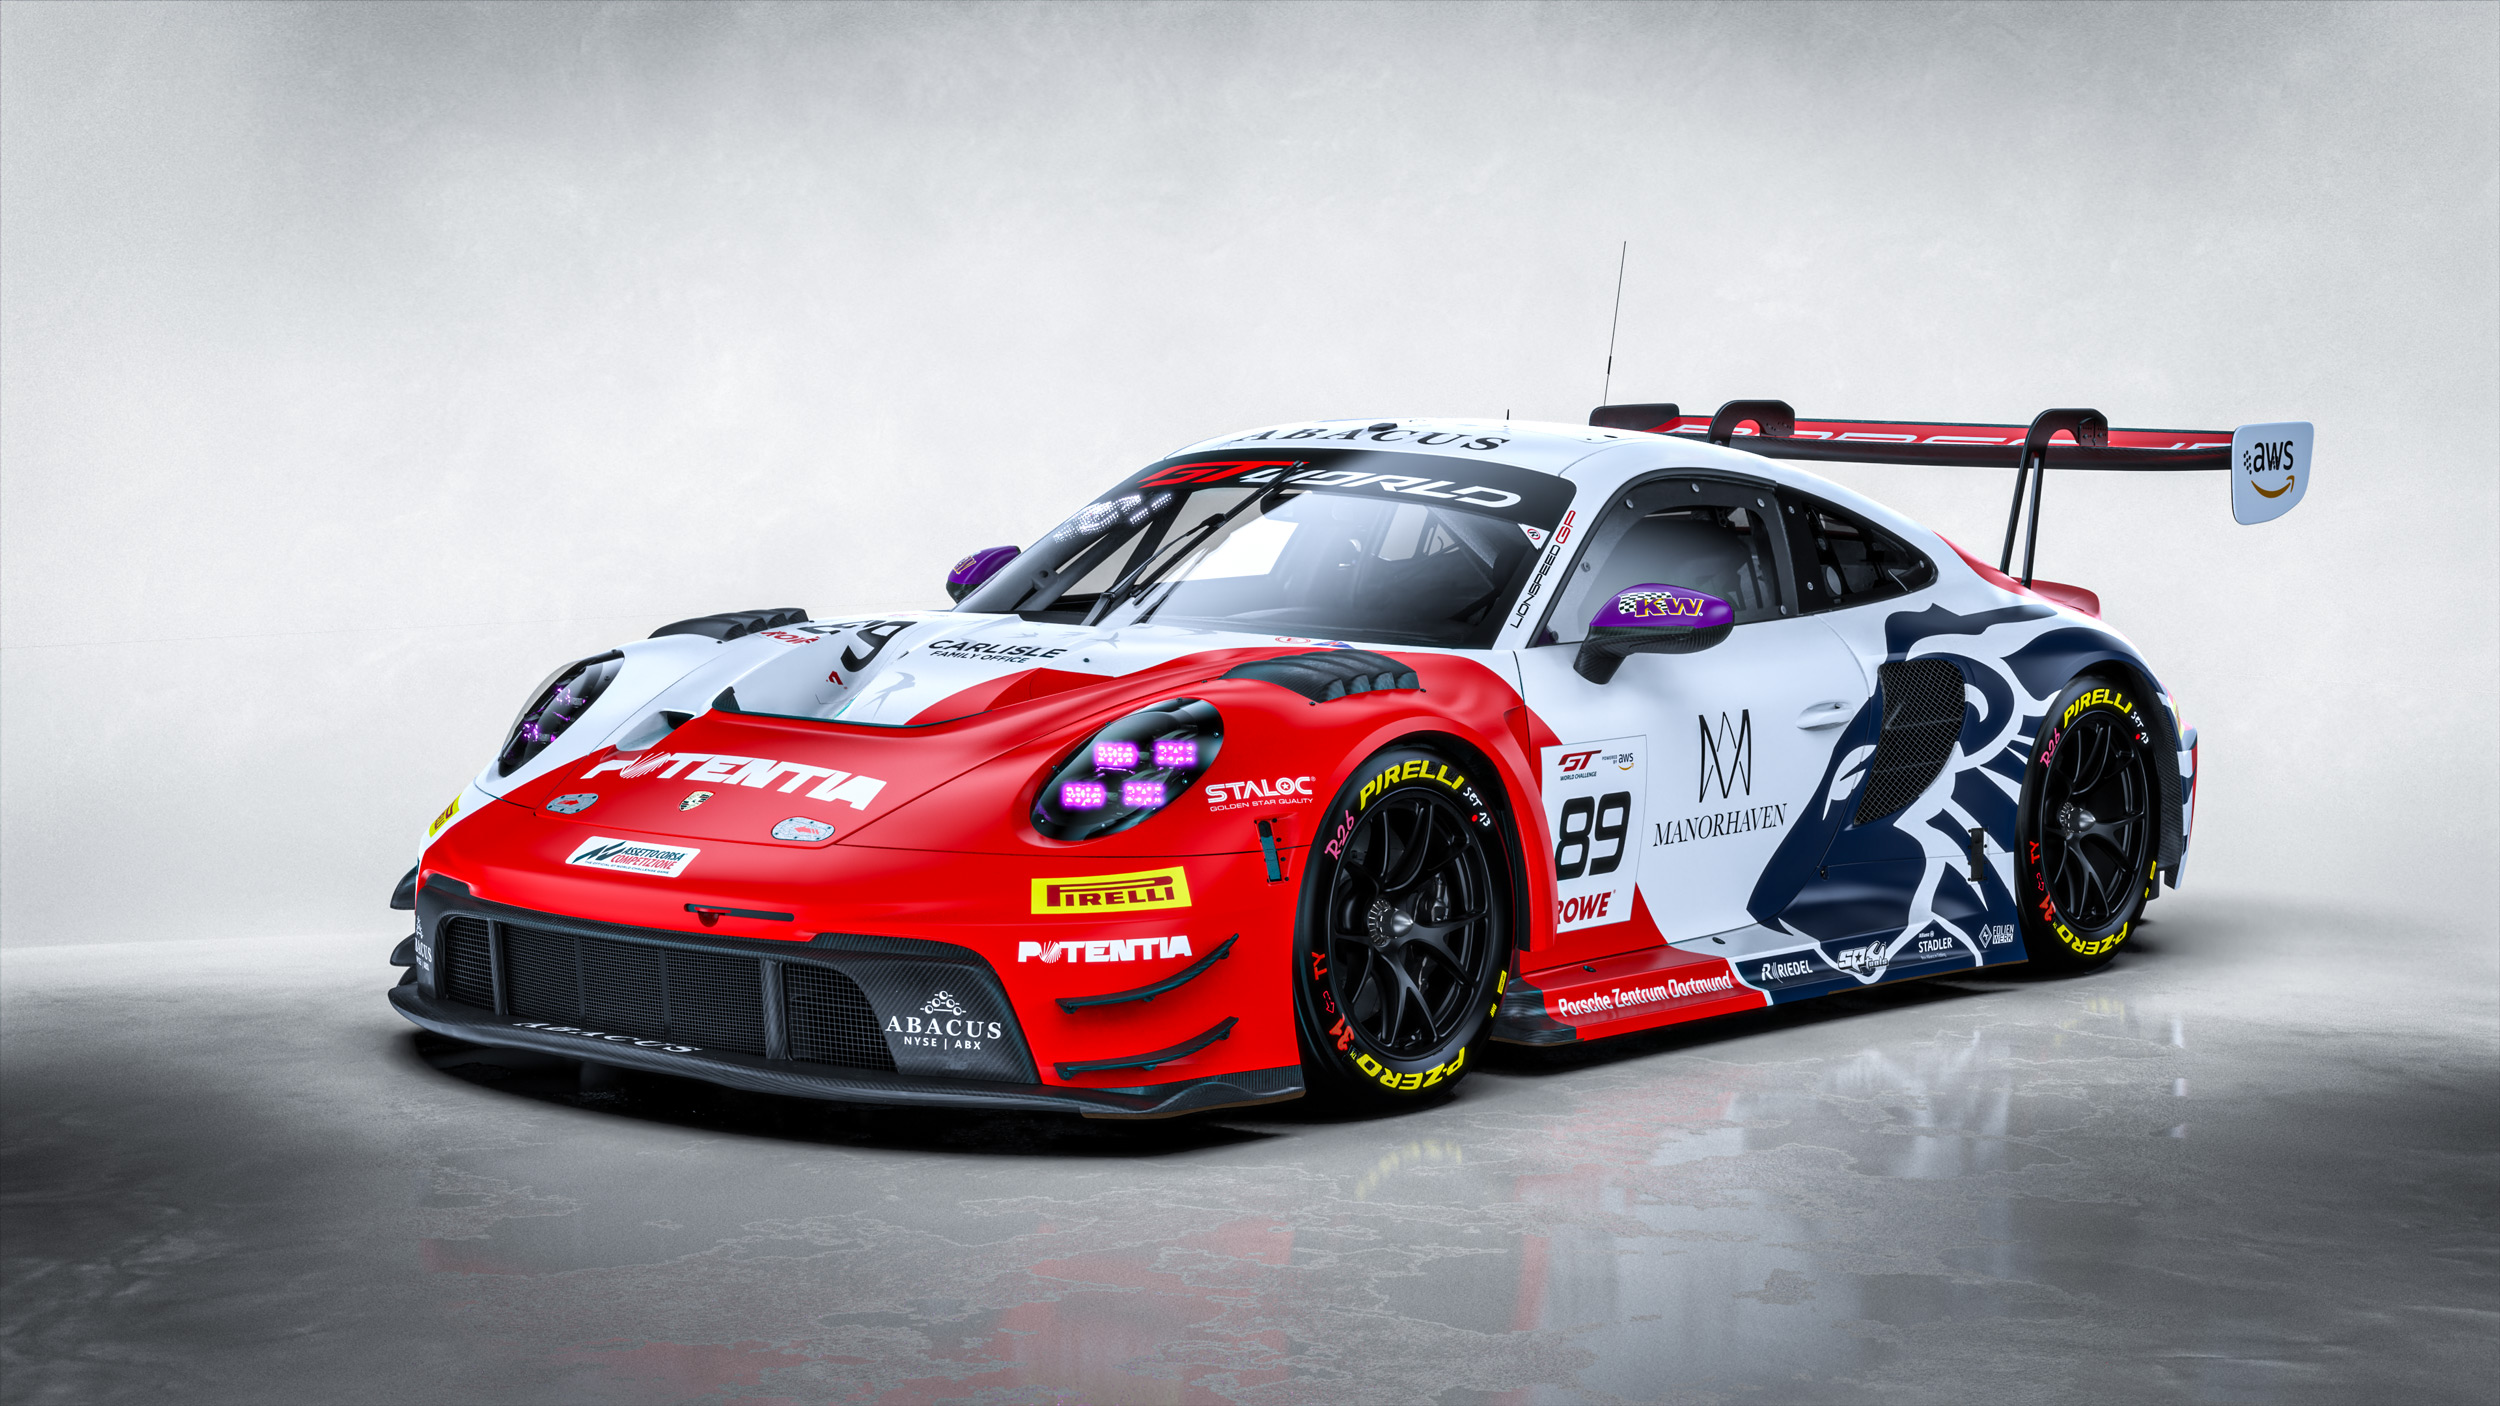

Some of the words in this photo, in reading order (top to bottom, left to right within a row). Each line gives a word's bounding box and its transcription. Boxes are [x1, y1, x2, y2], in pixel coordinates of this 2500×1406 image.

[1234, 428, 1510, 451] ABACUS
[2253, 440, 2294, 472] aws
[1510, 544, 1561, 629] LIONSPEED
[1555, 510, 1576, 544] GP
[1634, 597, 1704, 618] KW
[928, 639, 1068, 659] CARLISLE
[930, 650, 979, 660] FAMILY
[980, 654, 1030, 664] OFFICE
[2063, 688, 2133, 729] PIRELLI
[2130, 711, 2144, 728] SET
[1558, 749, 1602, 772] GT
[1618, 752, 1634, 764] aws
[1359, 759, 1465, 811] PIRELLI
[1575, 771, 1597, 780] CHALLENGE
[1205, 776, 1313, 804] STALOC
[1462, 786, 1483, 807] SET
[1210, 802, 1250, 812] GOLDEN
[1252, 799, 1277, 807] STAR
[1653, 803, 1788, 847] MANORHAVEN
[1555, 791, 1632, 881] 89
[610, 854, 678, 870] COMPETIZIONE
[1046, 875, 1175, 907] PIRELLI
[1992, 924, 2015, 935] FOLIEN
[1992, 934, 2014, 945] WERK
[1918, 937, 1953, 953] STADLER
[1777, 959, 1814, 978] RIEDEL
[1558, 991, 1614, 1017] Porsche
[1611, 985, 1669, 1008] Zentrum
[1667, 970, 1734, 998] Dortmund
[512, 1022, 702, 1053] ABACUS
[885, 1015, 1002, 1039] ABACUS
[904, 1036, 937, 1047] NYSE
[954, 1040, 981, 1050] ABX
